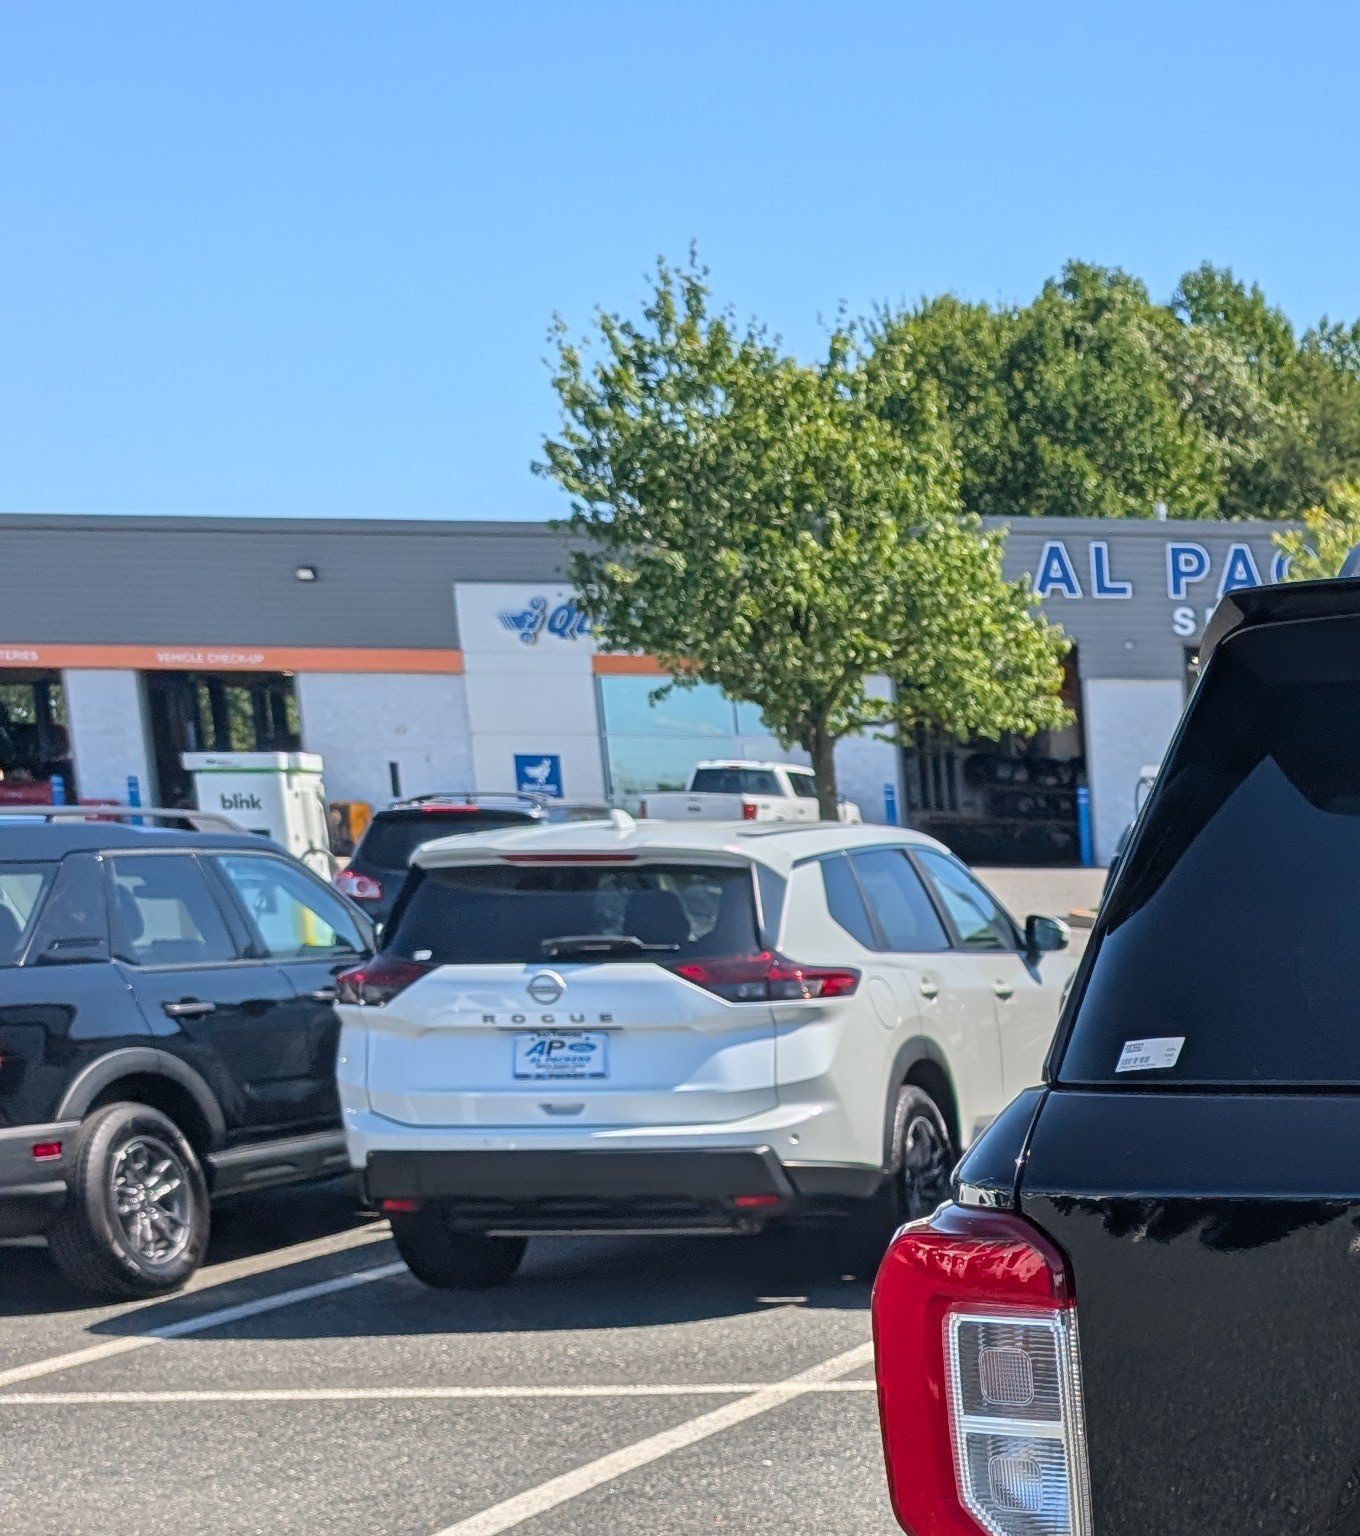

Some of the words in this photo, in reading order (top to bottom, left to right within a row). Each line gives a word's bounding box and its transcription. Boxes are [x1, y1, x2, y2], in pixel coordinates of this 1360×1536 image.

[1034, 540, 1133, 600] AL
[220, 792, 263, 811] blink
[482, 1012, 614, 1025] ROGUE
